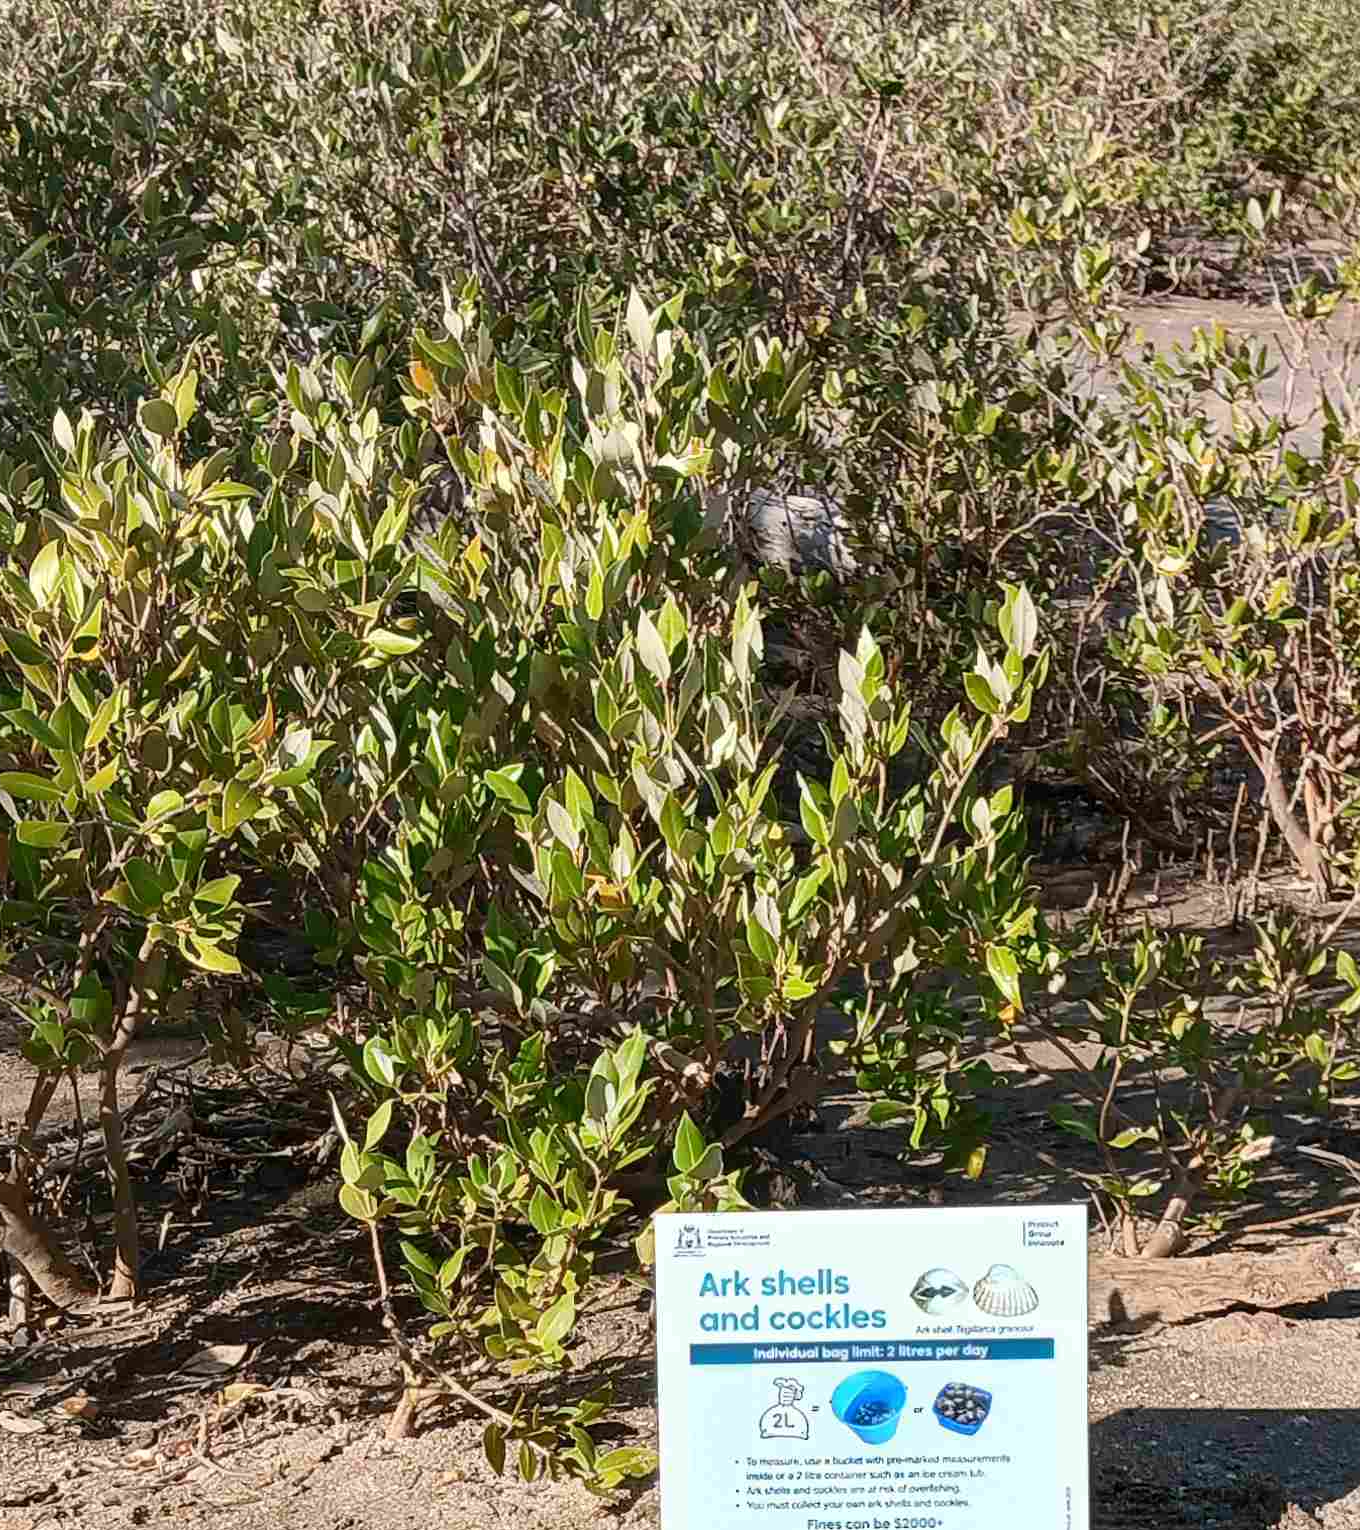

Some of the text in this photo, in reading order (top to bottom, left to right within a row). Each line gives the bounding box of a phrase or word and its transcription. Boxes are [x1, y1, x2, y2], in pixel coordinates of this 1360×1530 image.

[699, 1268, 850, 1297] Ark shells
[699, 1303, 887, 1332] and cockles
[753, 1343, 989, 1362] Individual bag limit: 2 litres per day
[913, 1406, 925, 1414] or
[772, 1412, 796, 1429] 2L
[870, 1470, 892, 1480] such
[908, 1471, 920, 1479] an
[807, 1517, 944, 1530] Fines can be $2000+
